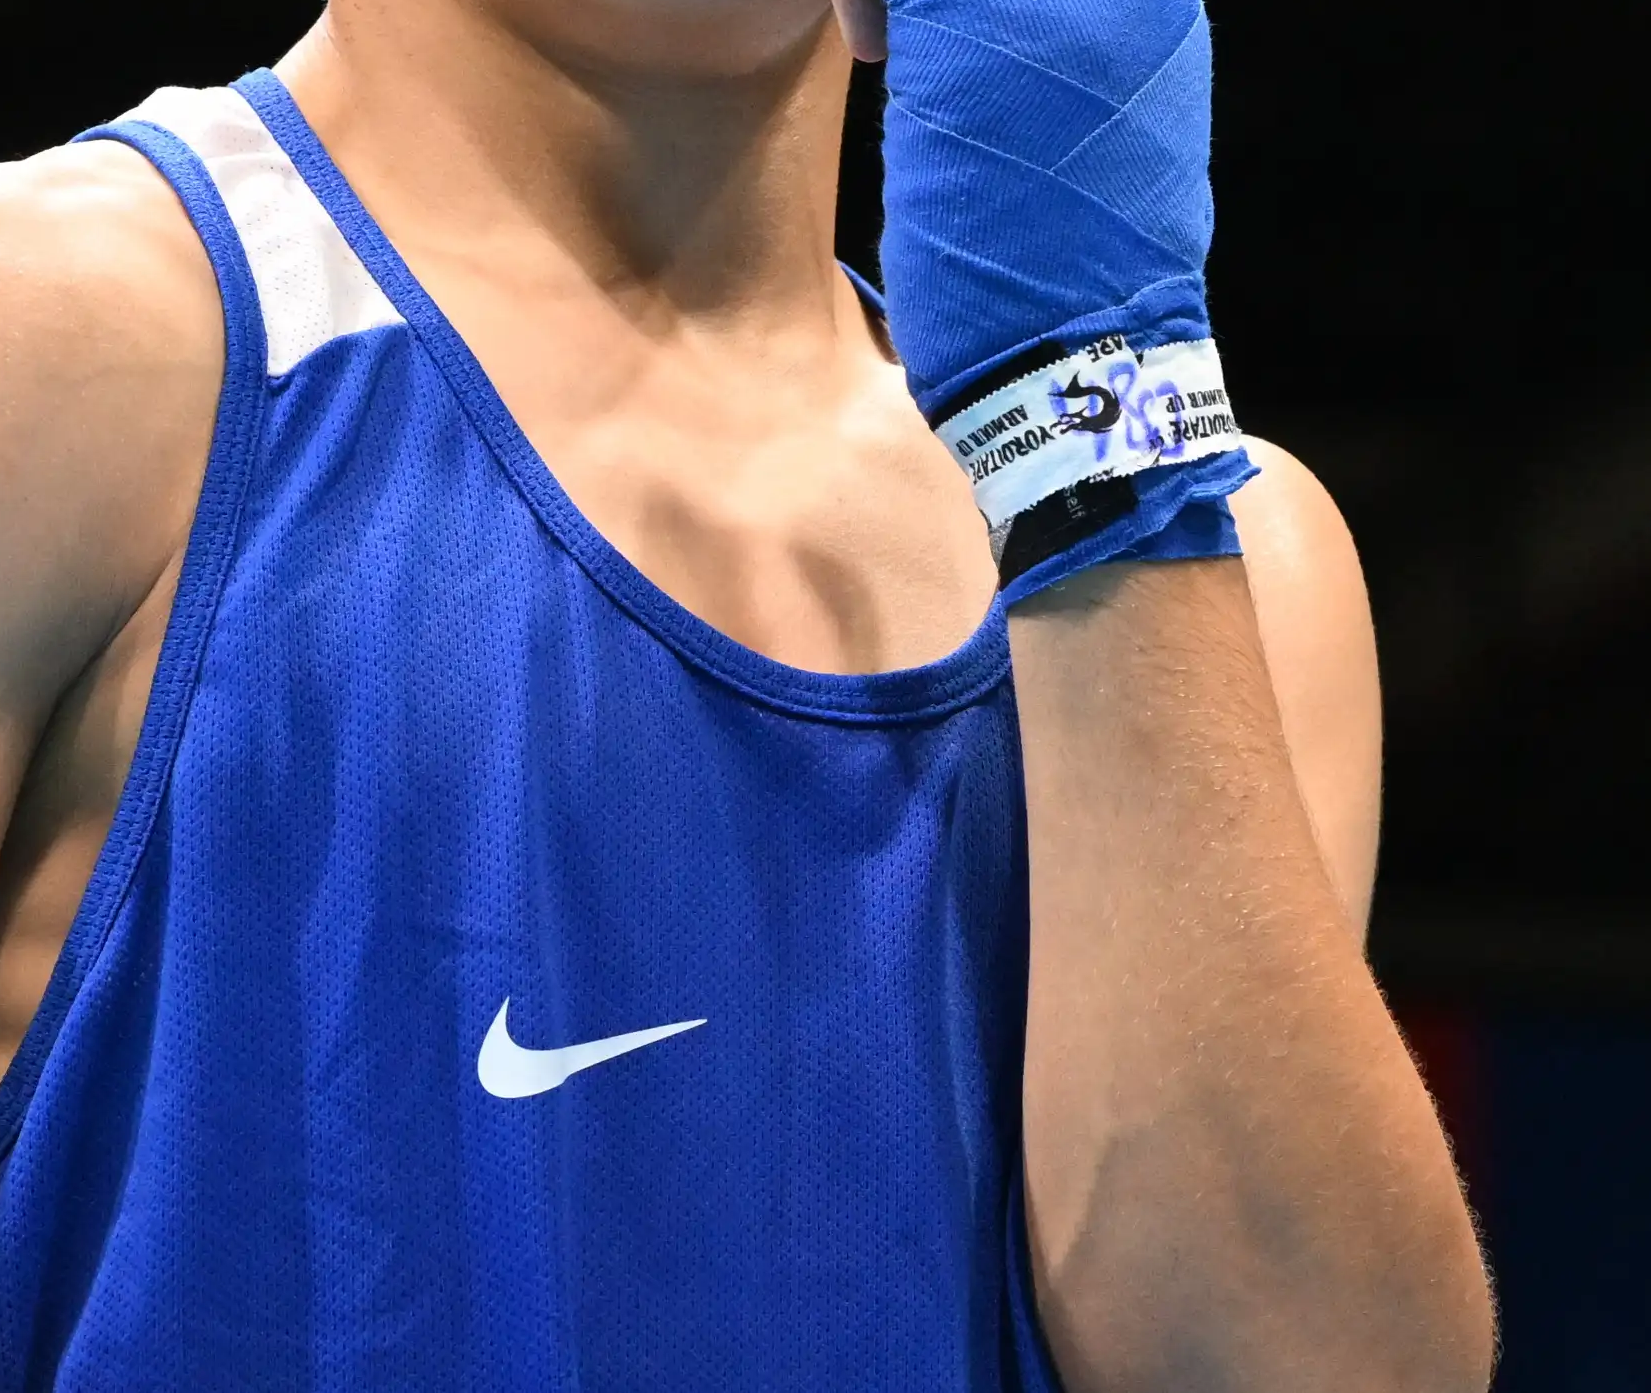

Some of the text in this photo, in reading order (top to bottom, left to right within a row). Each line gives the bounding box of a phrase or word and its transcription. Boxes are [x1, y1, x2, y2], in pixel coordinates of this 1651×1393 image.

[1166, 394, 1185, 413] UP
[956, 404, 1029, 457] ARMOUR UP
